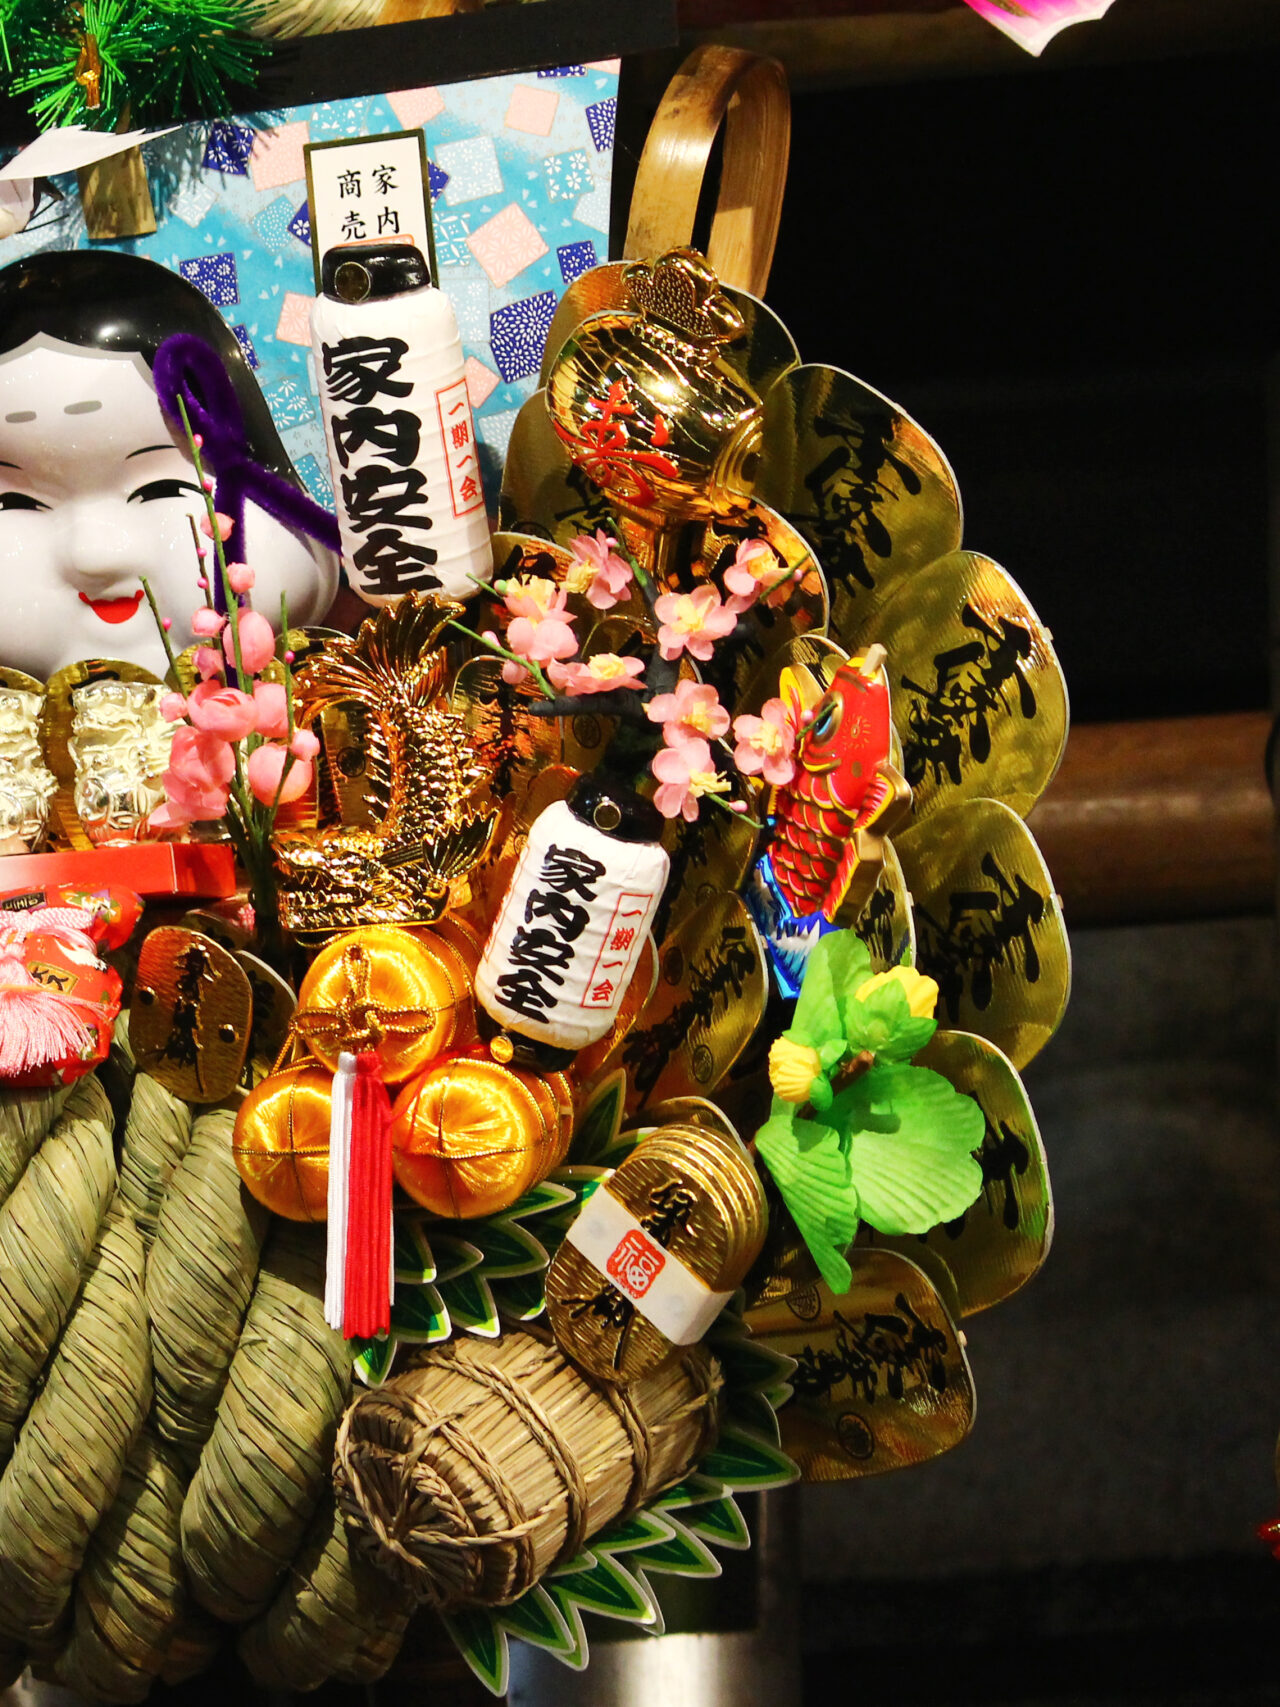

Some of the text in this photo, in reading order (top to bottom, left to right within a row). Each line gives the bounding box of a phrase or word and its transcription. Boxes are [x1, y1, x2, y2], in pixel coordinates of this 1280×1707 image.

[322, 336, 442, 596] 家内安全
[447, 400, 480, 499] 一期一会
[494, 844, 607, 1024] 家内安全
[592, 909, 642, 1002] 一期一会
